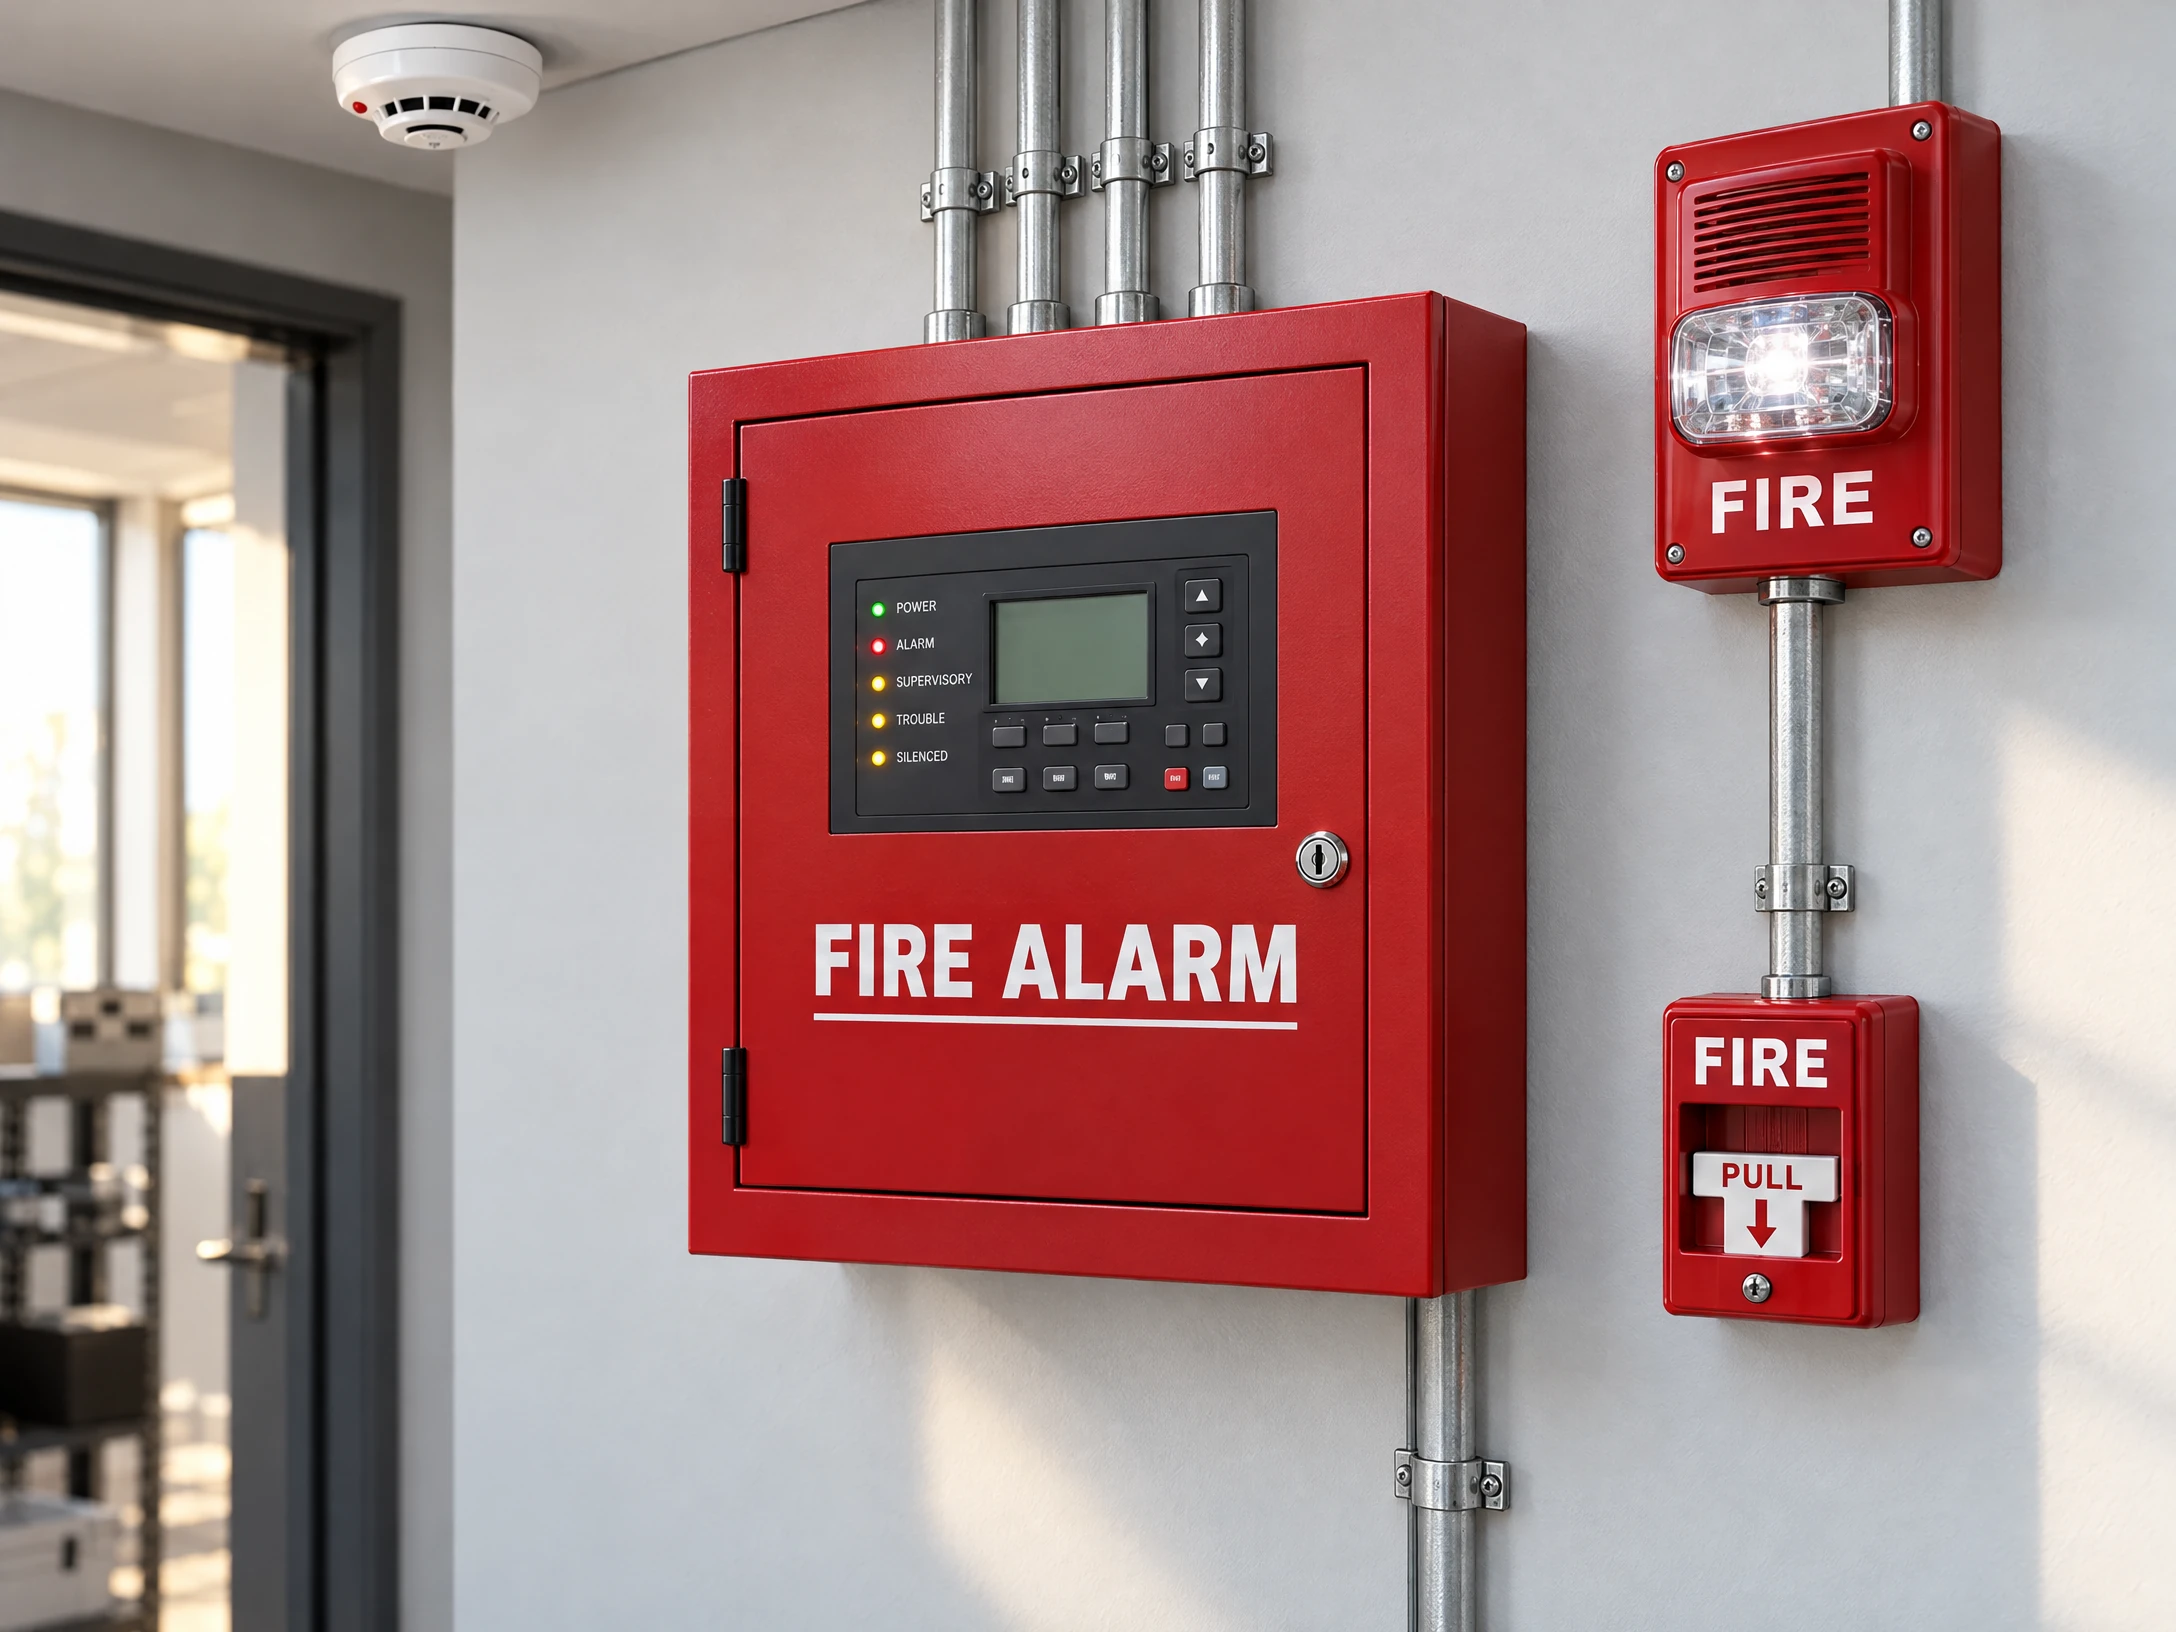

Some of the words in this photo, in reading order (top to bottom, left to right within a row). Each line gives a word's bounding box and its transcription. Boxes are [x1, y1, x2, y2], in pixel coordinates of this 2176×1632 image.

[1711, 470, 1874, 534] FIRE
[896, 600, 937, 614] POWER
[896, 637, 935, 651] ALARM
[896, 673, 973, 688] SUPERVISORY
[896, 712, 946, 726] TROUBLE
[896, 750, 949, 764] SILENCED
[815, 924, 973, 998] FIRE
[1002, 924, 1297, 1004] ALARM
[1695, 1037, 1828, 1089] FIRE
[1722, 1162, 1803, 1191] PULL
